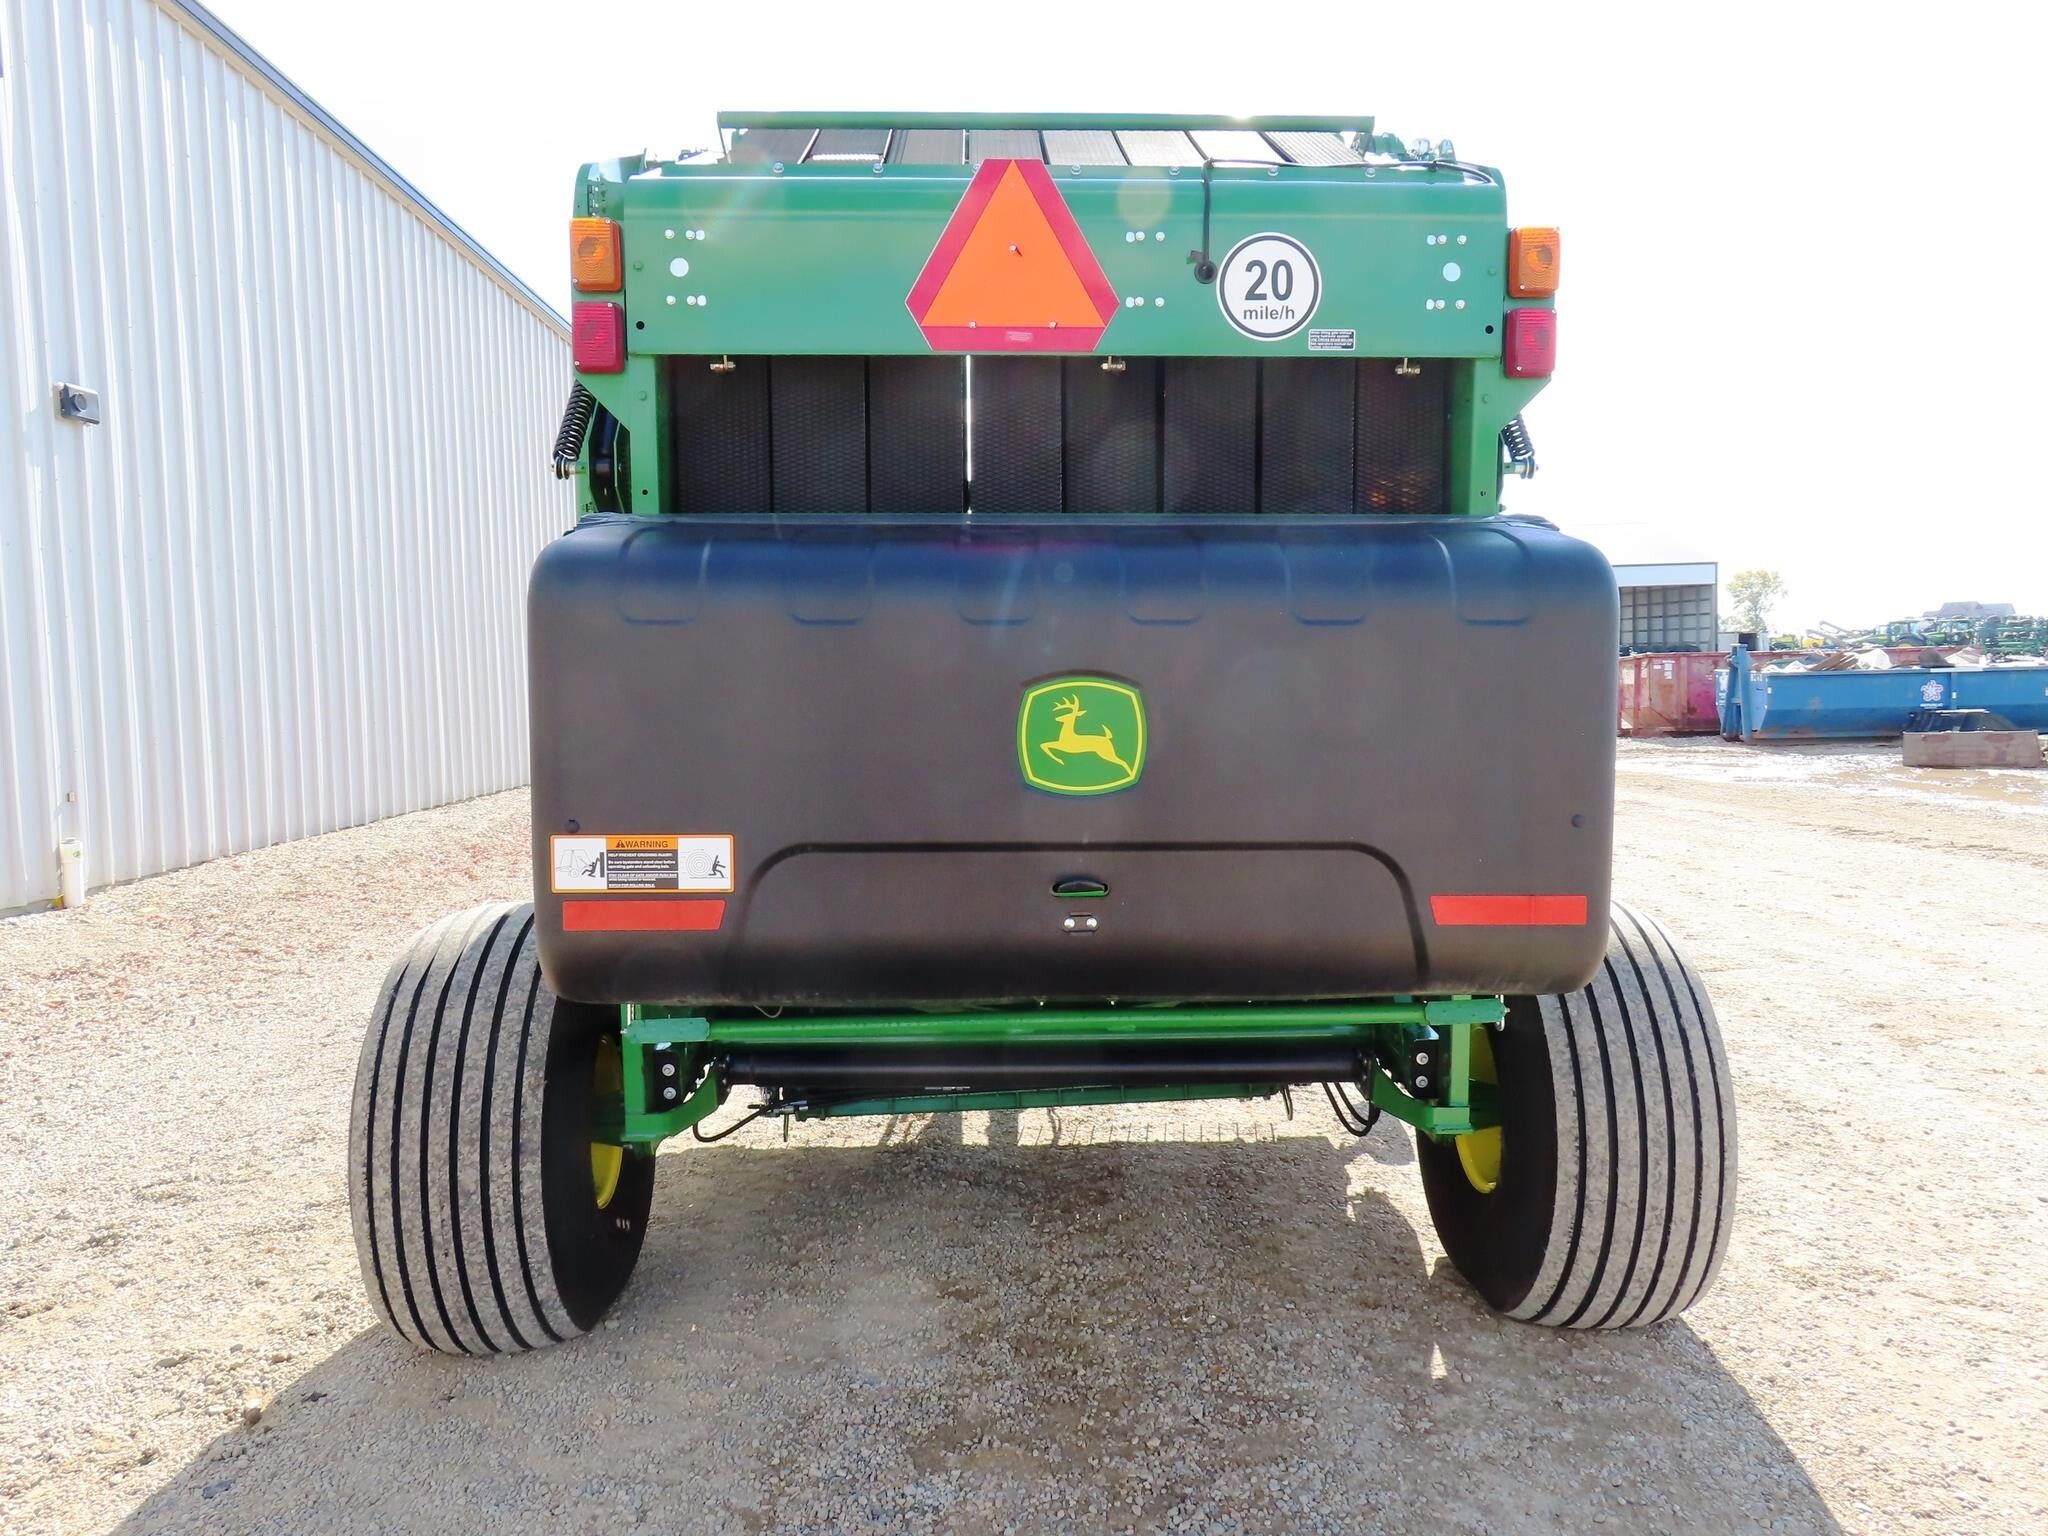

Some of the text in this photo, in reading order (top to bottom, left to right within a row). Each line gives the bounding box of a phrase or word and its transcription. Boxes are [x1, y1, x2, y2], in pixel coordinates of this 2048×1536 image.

[1244, 259, 1294, 301] 20
[1243, 305, 1295, 320] mile/h
[625, 840, 669, 849] WARNING
